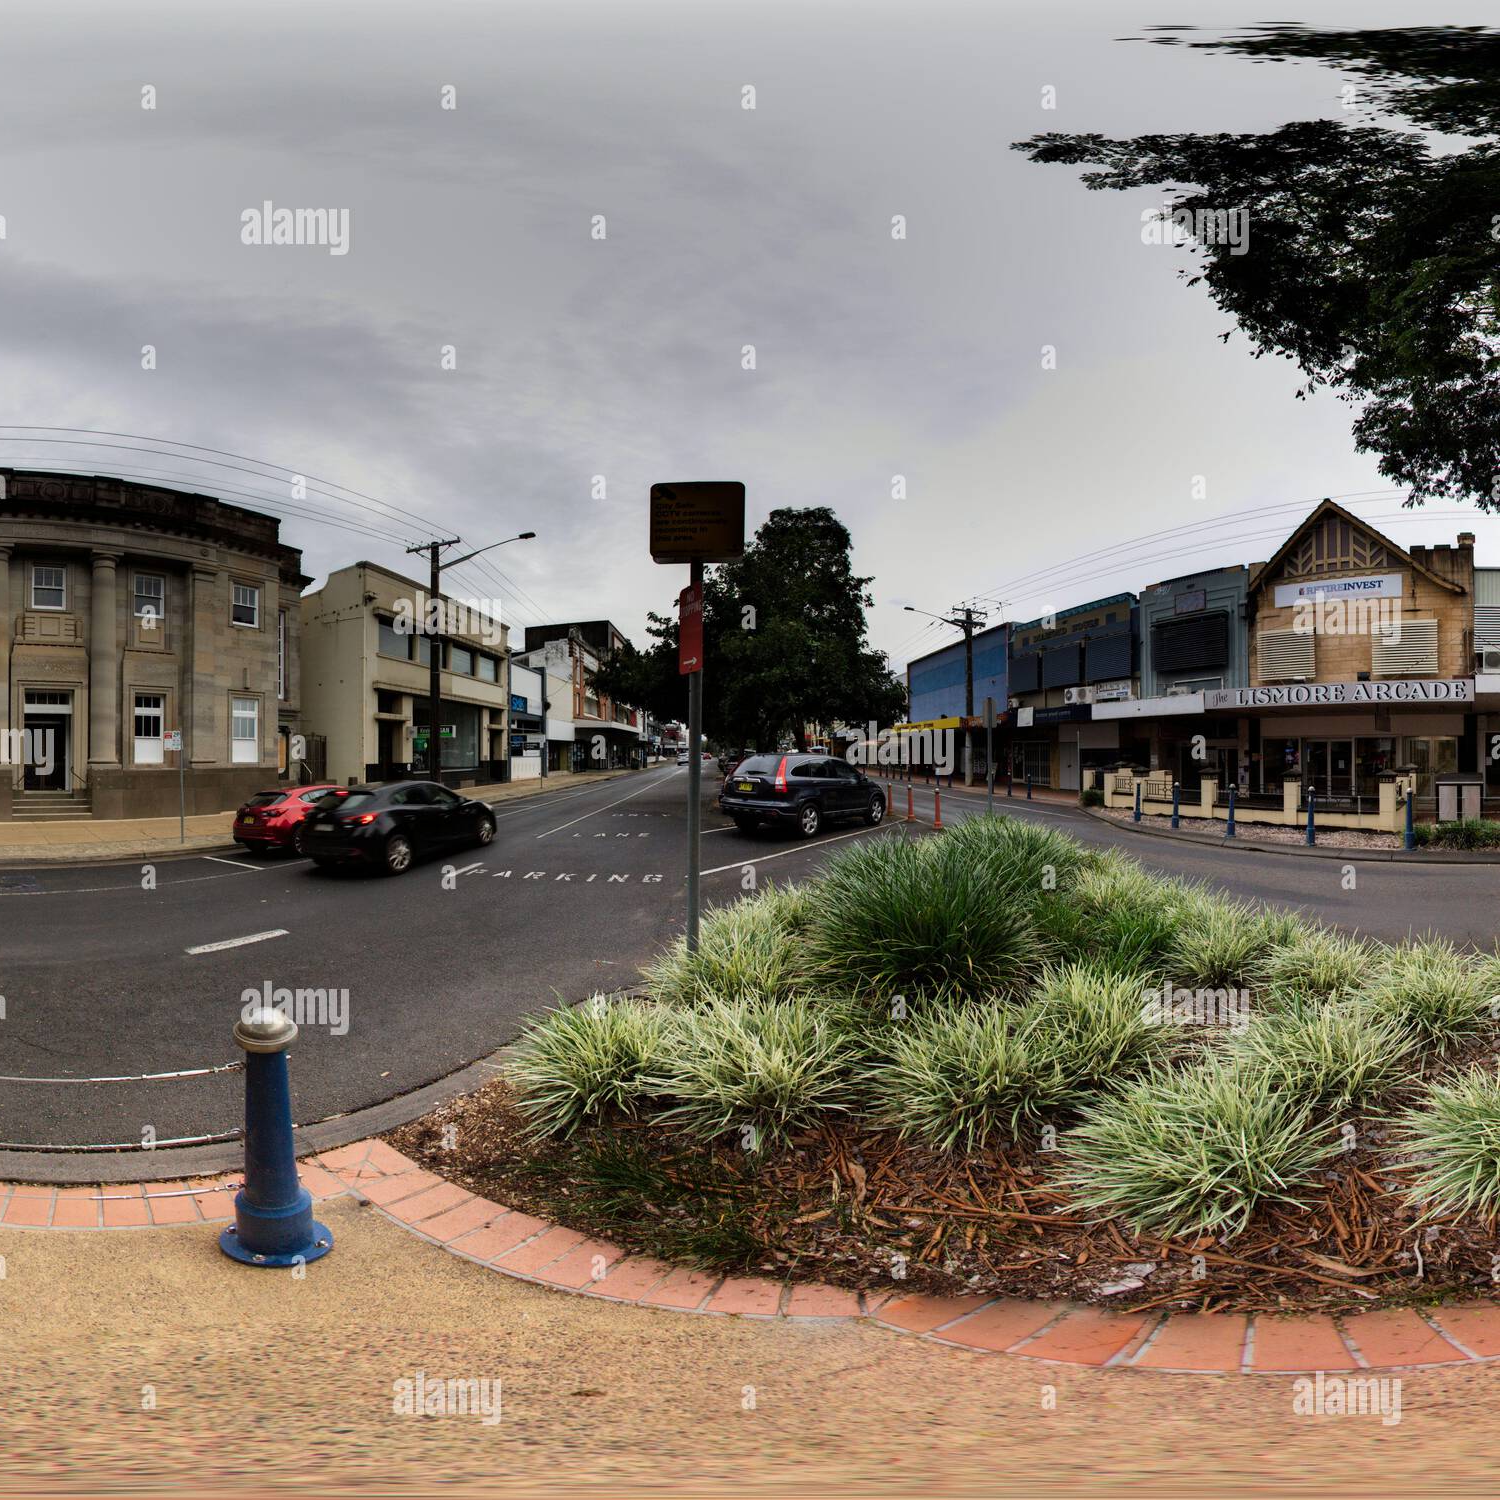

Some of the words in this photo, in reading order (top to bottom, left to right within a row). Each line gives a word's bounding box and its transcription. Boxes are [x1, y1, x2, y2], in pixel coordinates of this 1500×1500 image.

[1212, 693, 1228, 707] The
[1235, 684, 1345, 706] LISMORE
[1351, 681, 1466, 701] ARCADE
[465, 868, 664, 883] PARKING
